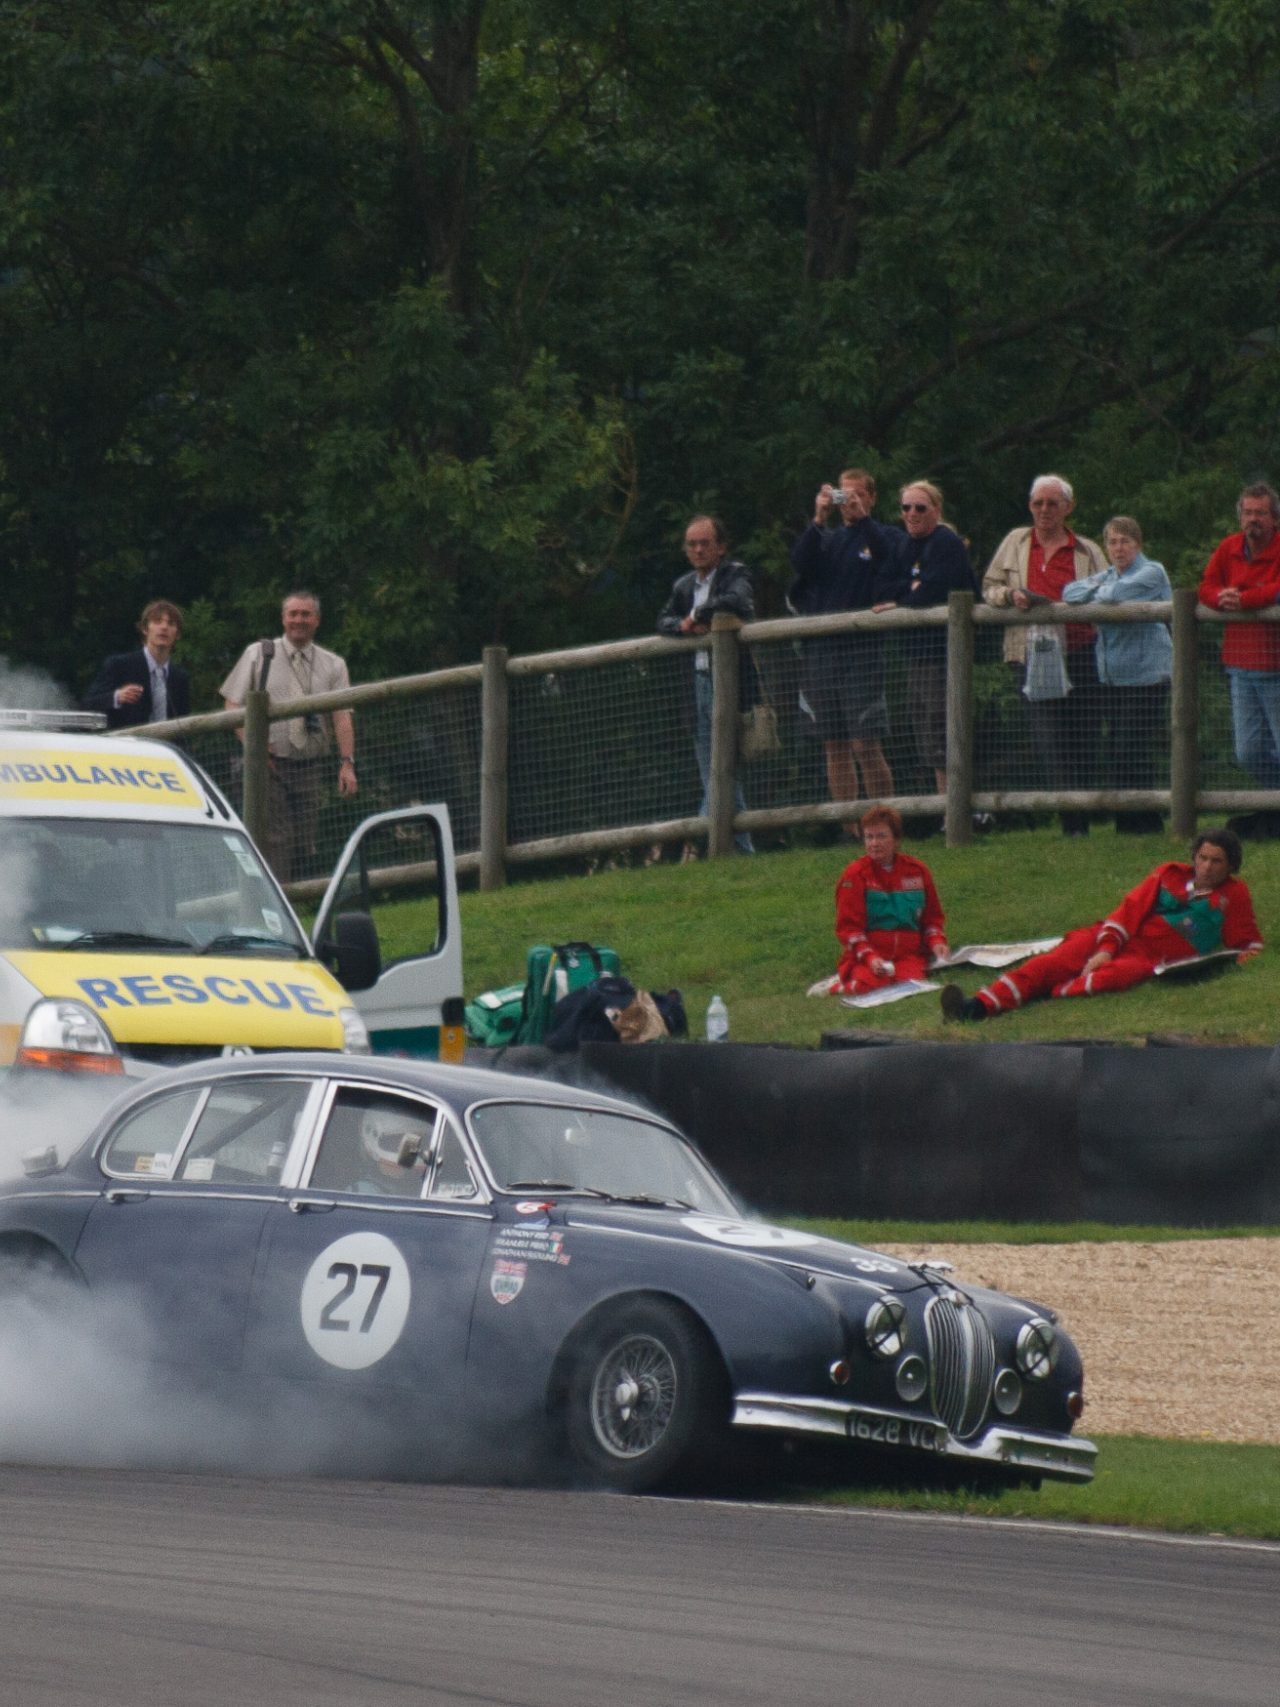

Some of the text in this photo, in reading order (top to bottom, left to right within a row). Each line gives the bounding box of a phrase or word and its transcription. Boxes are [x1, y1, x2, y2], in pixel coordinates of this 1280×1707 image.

[77, 975, 335, 1017] RESCUE
[320, 1262, 391, 1333] 27
[849, 1413, 901, 1445] 1628
